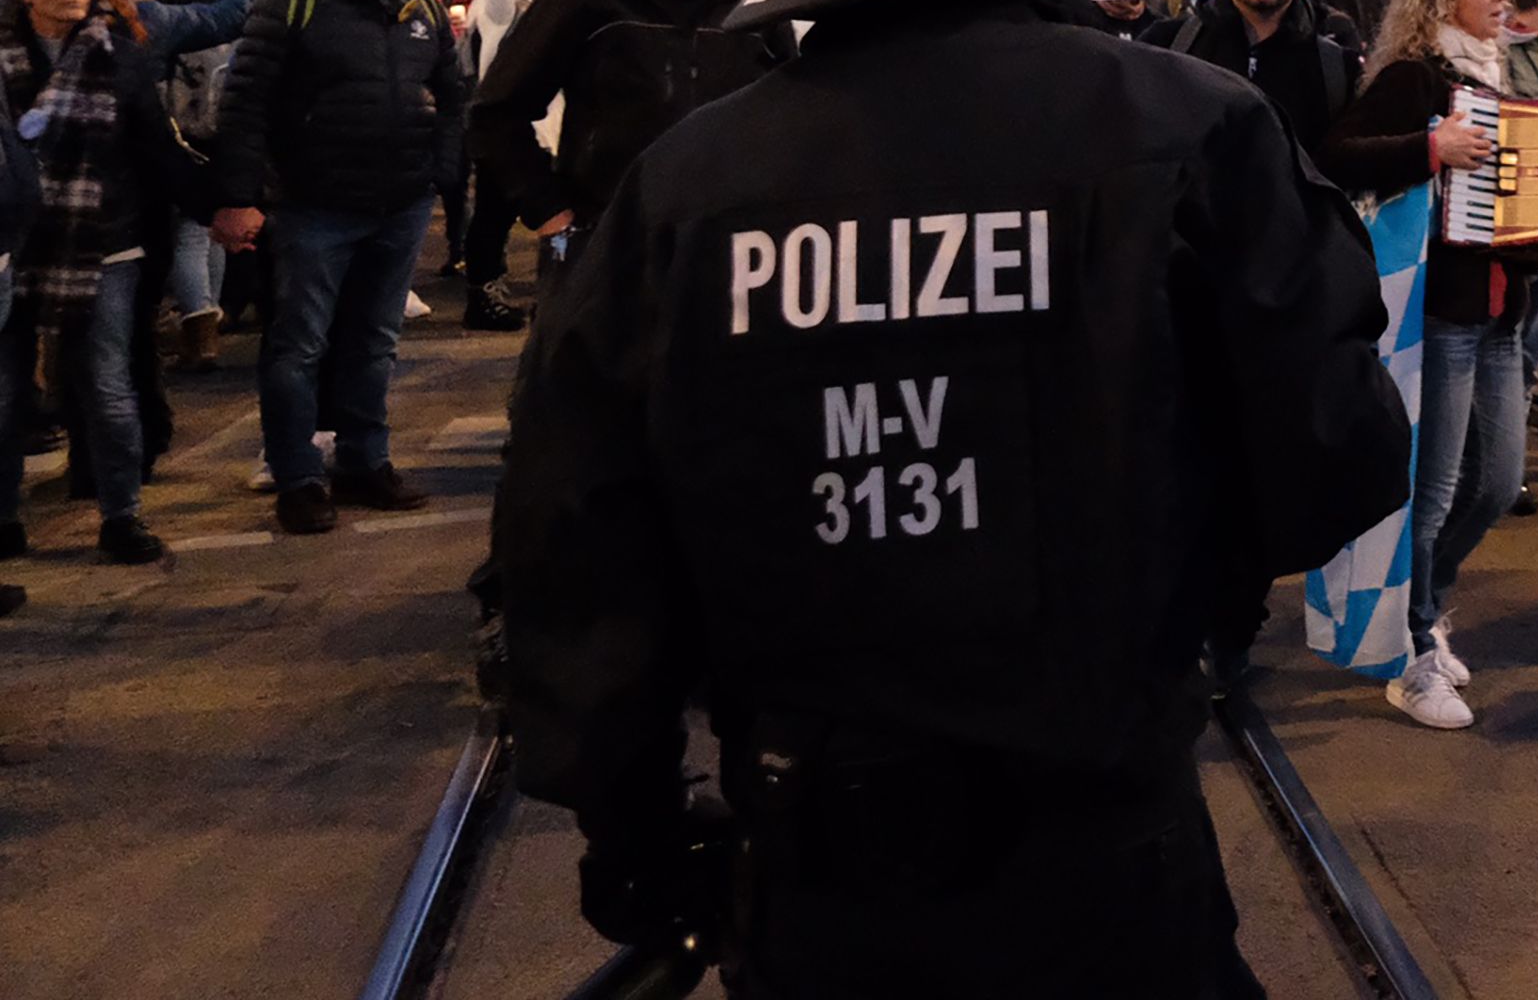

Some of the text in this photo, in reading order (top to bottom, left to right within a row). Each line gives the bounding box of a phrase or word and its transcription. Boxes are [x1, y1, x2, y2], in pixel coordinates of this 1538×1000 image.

[731, 209, 1050, 335] POLIZEI
[823, 375, 949, 459] M-V
[812, 456, 980, 545] 3131
